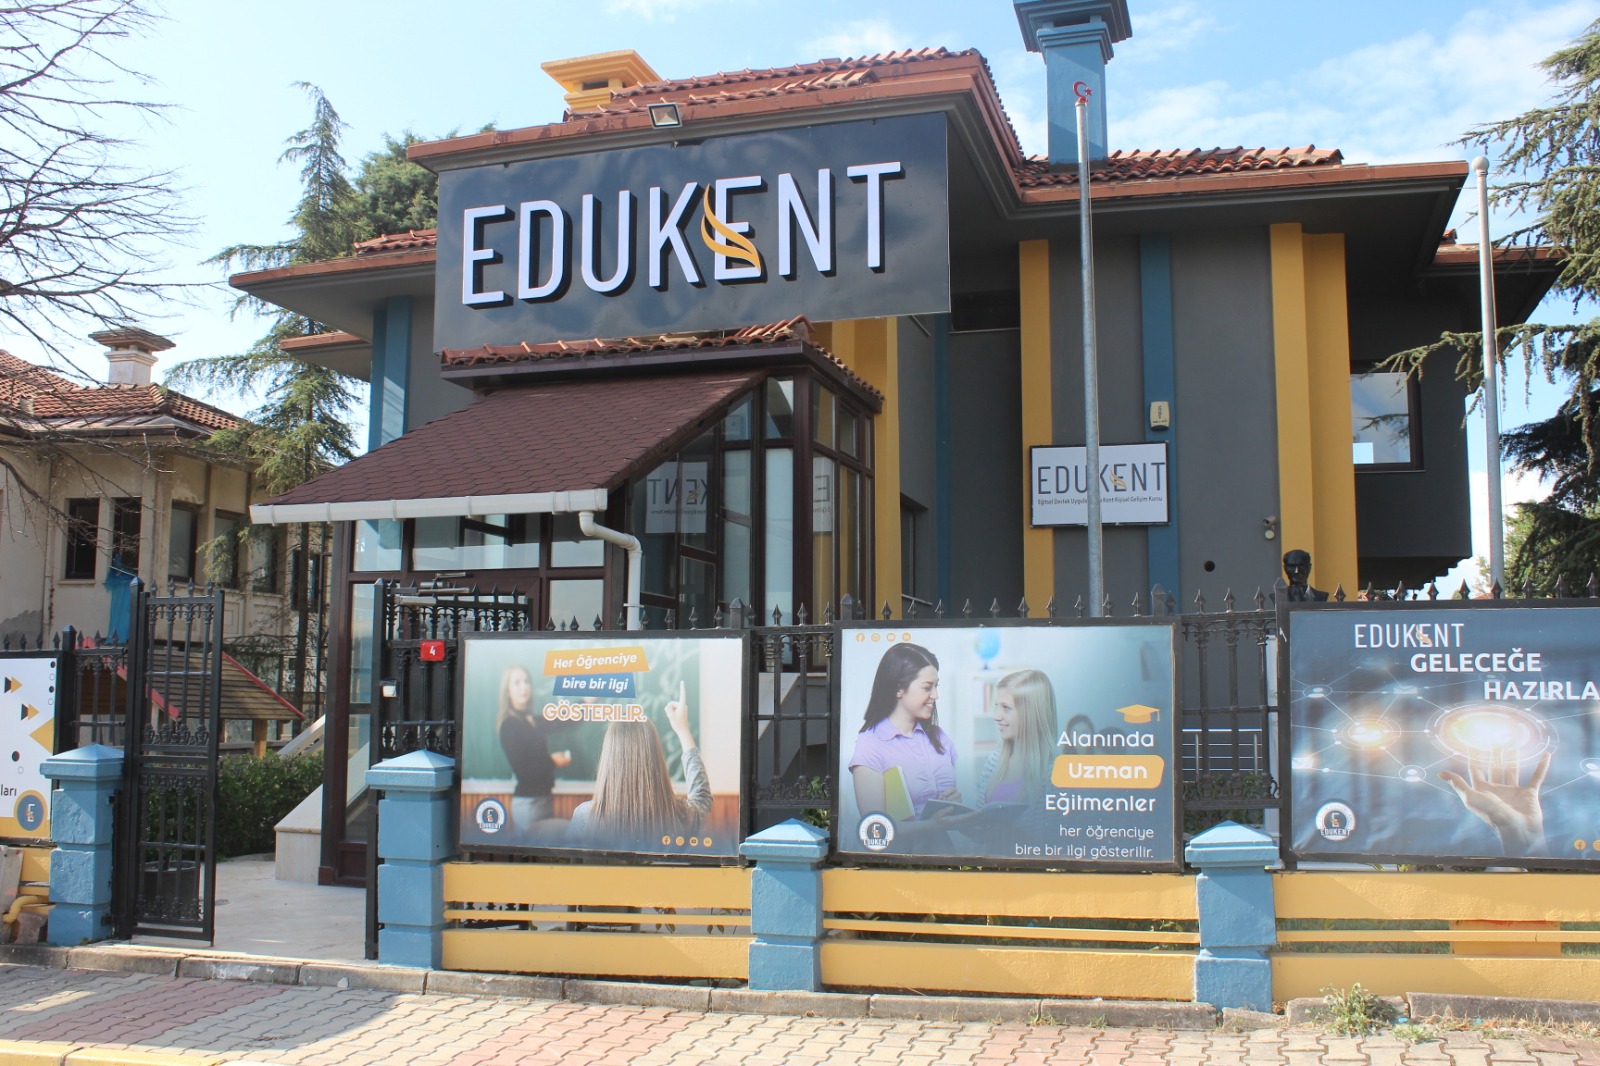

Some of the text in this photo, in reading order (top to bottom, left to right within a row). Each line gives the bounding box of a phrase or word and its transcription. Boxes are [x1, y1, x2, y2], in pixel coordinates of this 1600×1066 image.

[462, 161, 902, 306] EDUKENT
[1038, 462, 1166, 495] EDUKENT
[1354, 623, 1465, 648] EDUKENT
[429, 645, 436, 656] 4
[553, 653, 638, 670] Her Öğrenciye
[1410, 647, 1542, 673] GELECEĞE
[562, 677, 629, 694] bire bir ilgi
[1483, 681, 1600, 700] HAZIRLA
[1056, 731, 1154, 748] Alanında
[1068, 762, 1148, 779] Uzman
[1045, 792, 1156, 816] Eğitmenler
[1060, 824, 1154, 841] her öğrenciye
[1320, 828, 1352, 837] EDUKENT
[1015, 843, 1154, 859] bire bir ilgi gösterilir.
